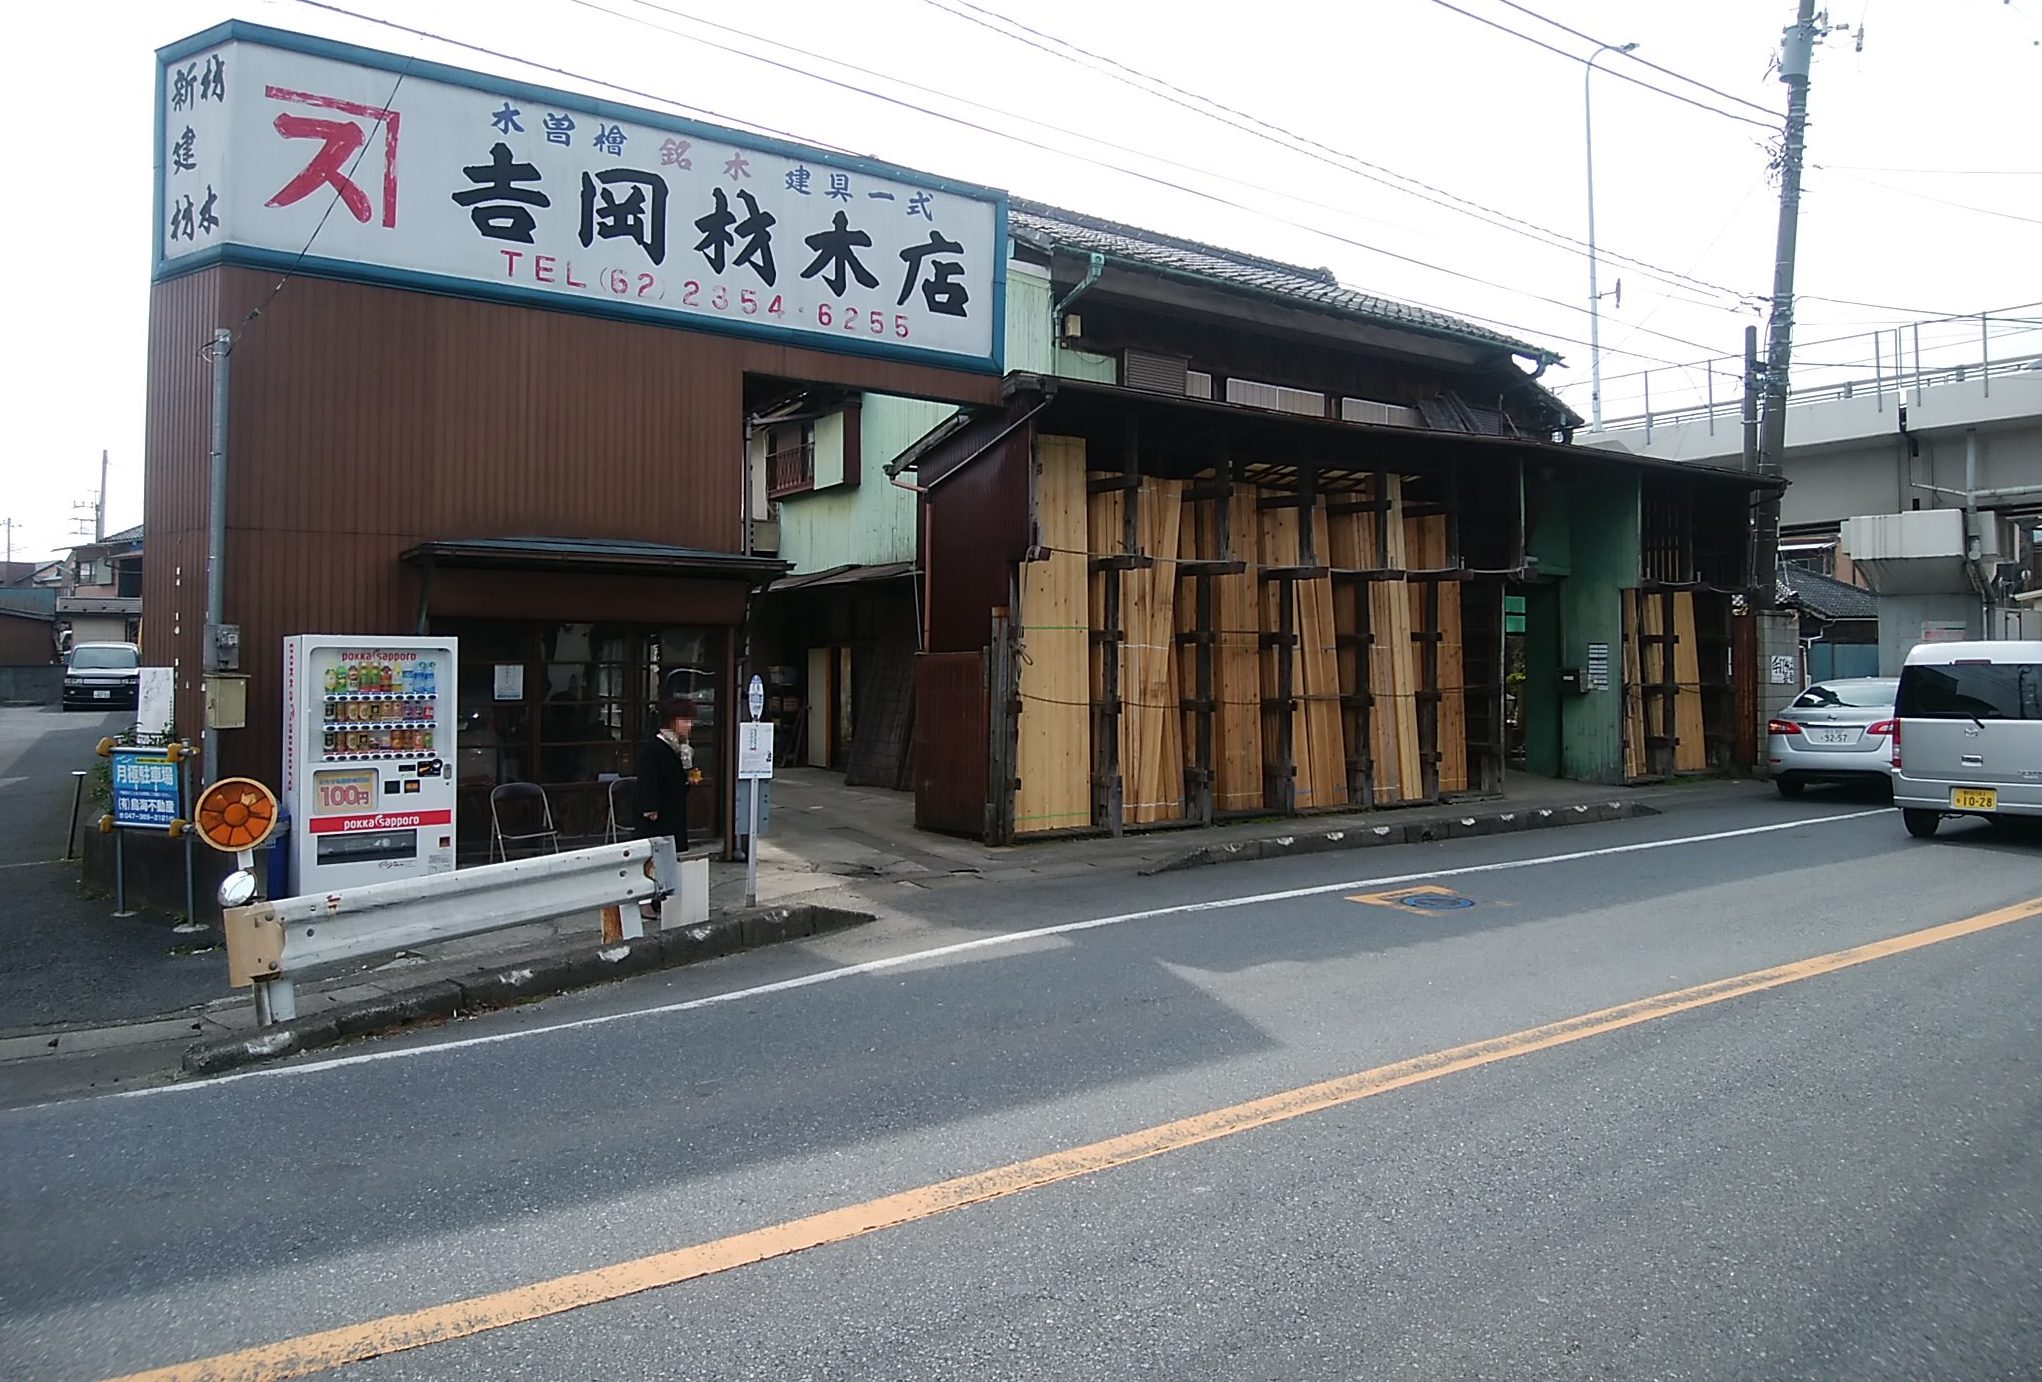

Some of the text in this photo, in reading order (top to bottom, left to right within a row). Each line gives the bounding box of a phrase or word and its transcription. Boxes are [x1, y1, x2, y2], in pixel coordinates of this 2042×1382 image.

[117, 765, 173, 786] 月極駐車場
[320, 785, 369, 806] 100円
